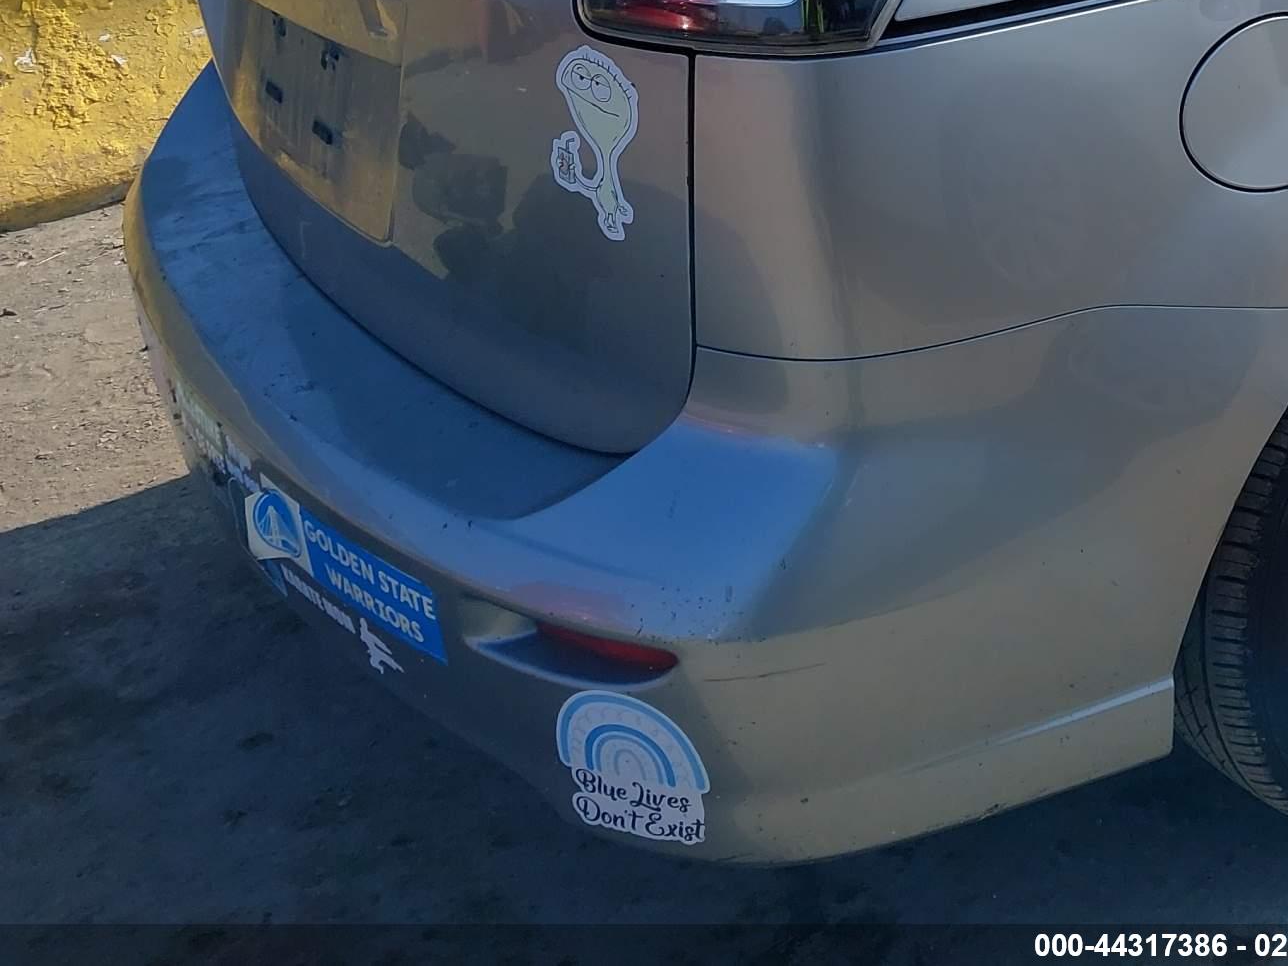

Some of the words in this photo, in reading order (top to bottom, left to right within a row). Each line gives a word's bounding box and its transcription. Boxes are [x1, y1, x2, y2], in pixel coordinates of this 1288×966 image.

[304, 520, 375, 584] GOLDEN
[377, 570, 436, 620] STATE
[324, 563, 424, 643] WARRIORS
[575, 768, 627, 801] Blue
[629, 782, 692, 813] Lives
[576, 796, 644, 831] Don't
[645, 812, 705, 842] Exist
